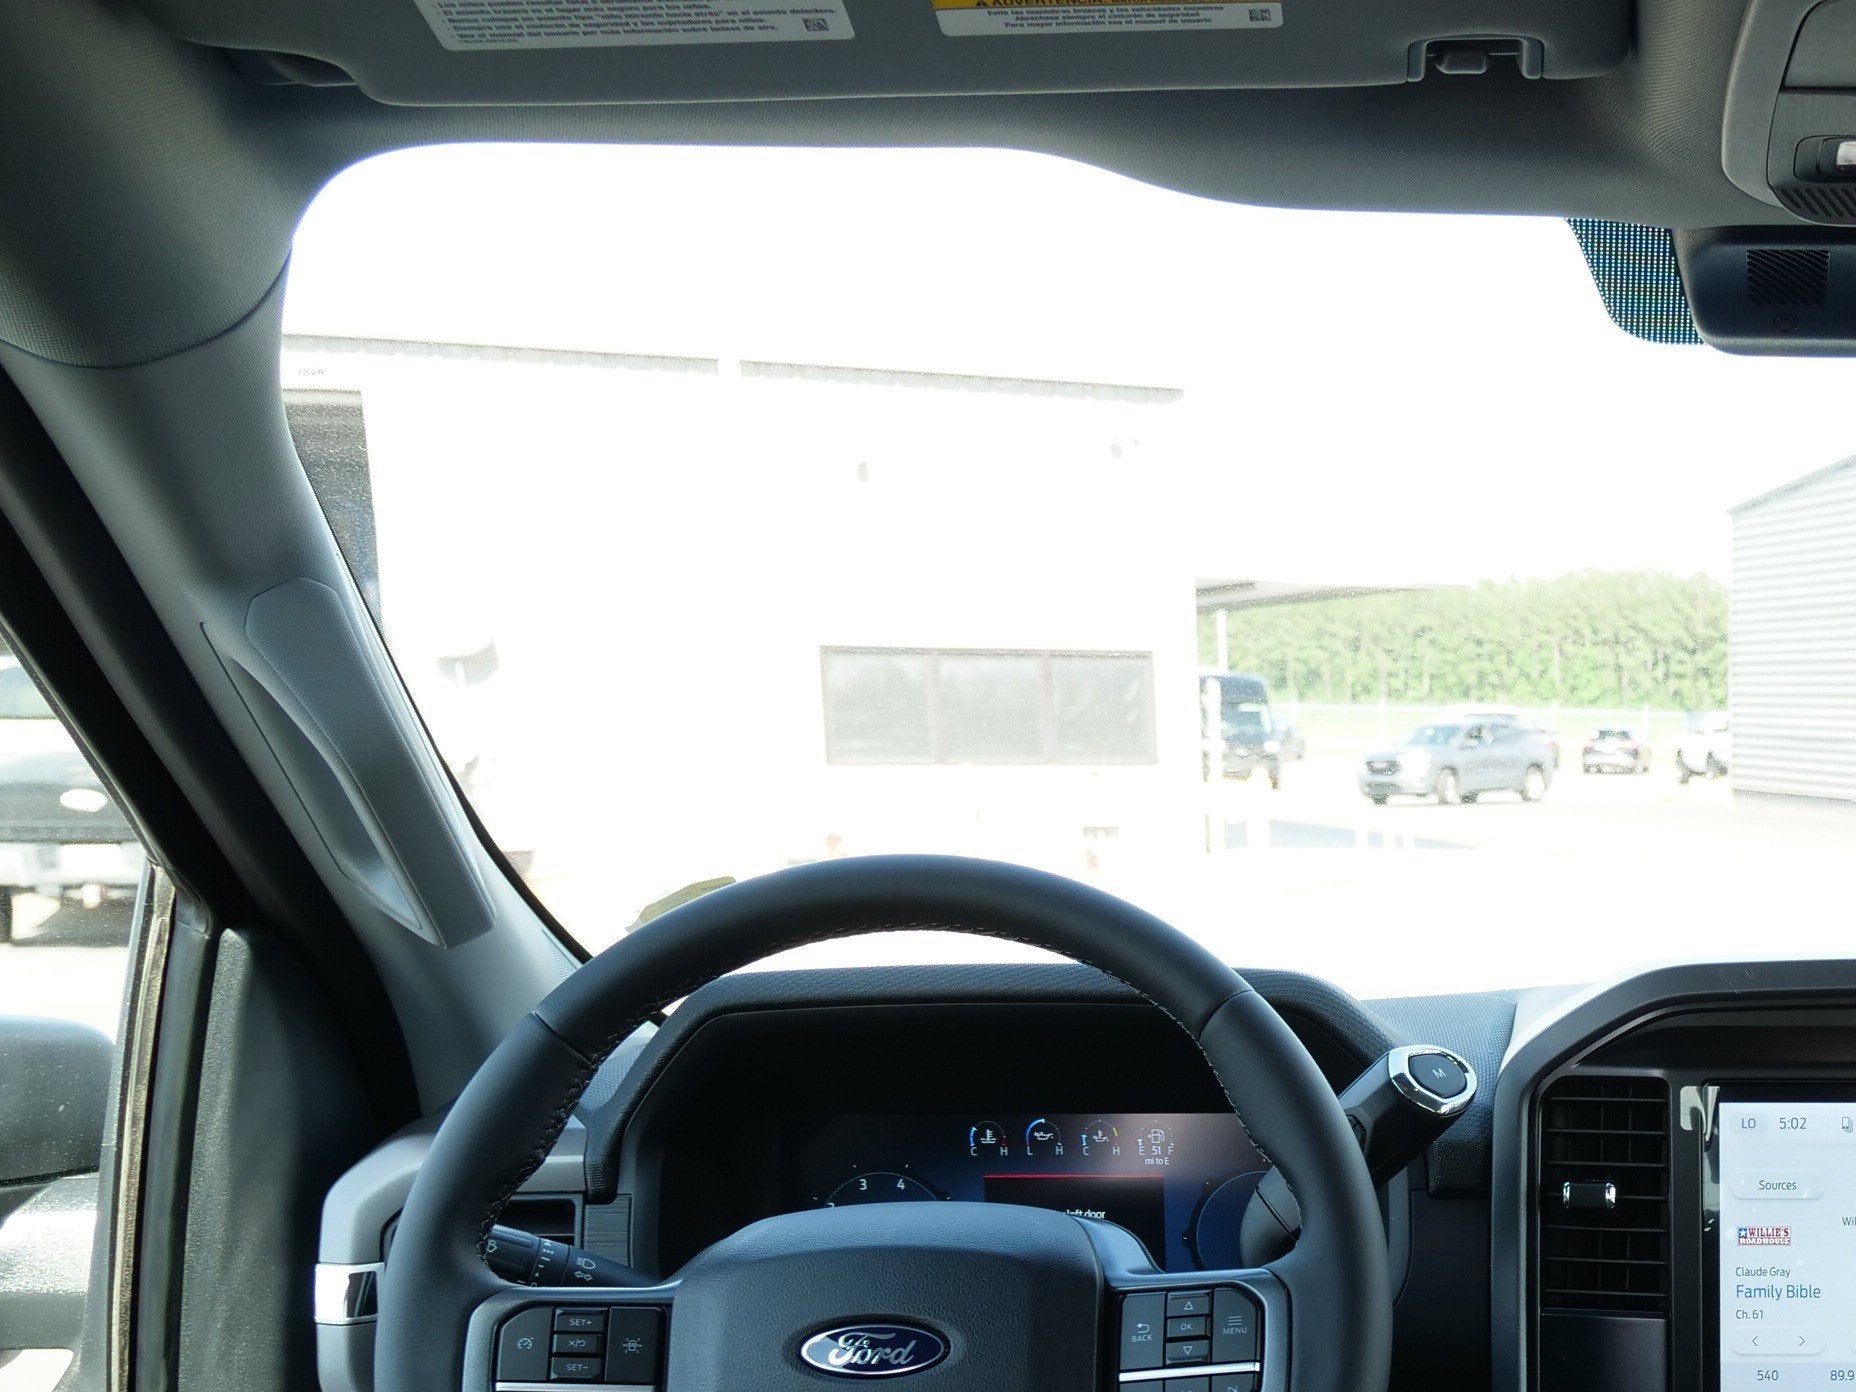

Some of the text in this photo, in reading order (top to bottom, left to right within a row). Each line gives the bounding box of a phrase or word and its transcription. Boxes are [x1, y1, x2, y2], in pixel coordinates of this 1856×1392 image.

[1432, 1068, 1447, 1079] M
[1741, 1117, 1756, 1129] LO
[1779, 1117, 1807, 1130] 5:02
[970, 1147, 977, 1156] C
[1000, 1146, 1008, 1156] H
[1027, 1147, 1033, 1156] L
[1056, 1146, 1064, 1156] H
[1083, 1147, 1090, 1156] C
[1112, 1147, 1120, 1156] H
[1139, 1147, 1145, 1155] E
[1152, 1146, 1161, 1155] 51
[1168, 1147, 1174, 1155] F
[859, 1178, 868, 1191] 3
[897, 1178, 906, 1190] 4
[1758, 1179, 1797, 1191] Sources
[1084, 1209, 1106, 1218] door
[1748, 1227, 1790, 1237] WILLIE'S
[1739, 1237, 1791, 1245] ROADHOUSE
[1735, 1266, 1791, 1279] Claude Gray
[1736, 1284, 1821, 1301] Family Bible
[1735, 1309, 1764, 1320] Ch. 61
[569, 1318, 592, 1327] SET+
[1180, 1323, 1192, 1331] OK
[1222, 1326, 1248, 1335] MENU
[1131, 1334, 1153, 1343] BACK
[828, 1331, 917, 1366] Ford
[1757, 1369, 1779, 1381] 540
[1829, 1369, 1855, 1381] 89.9
